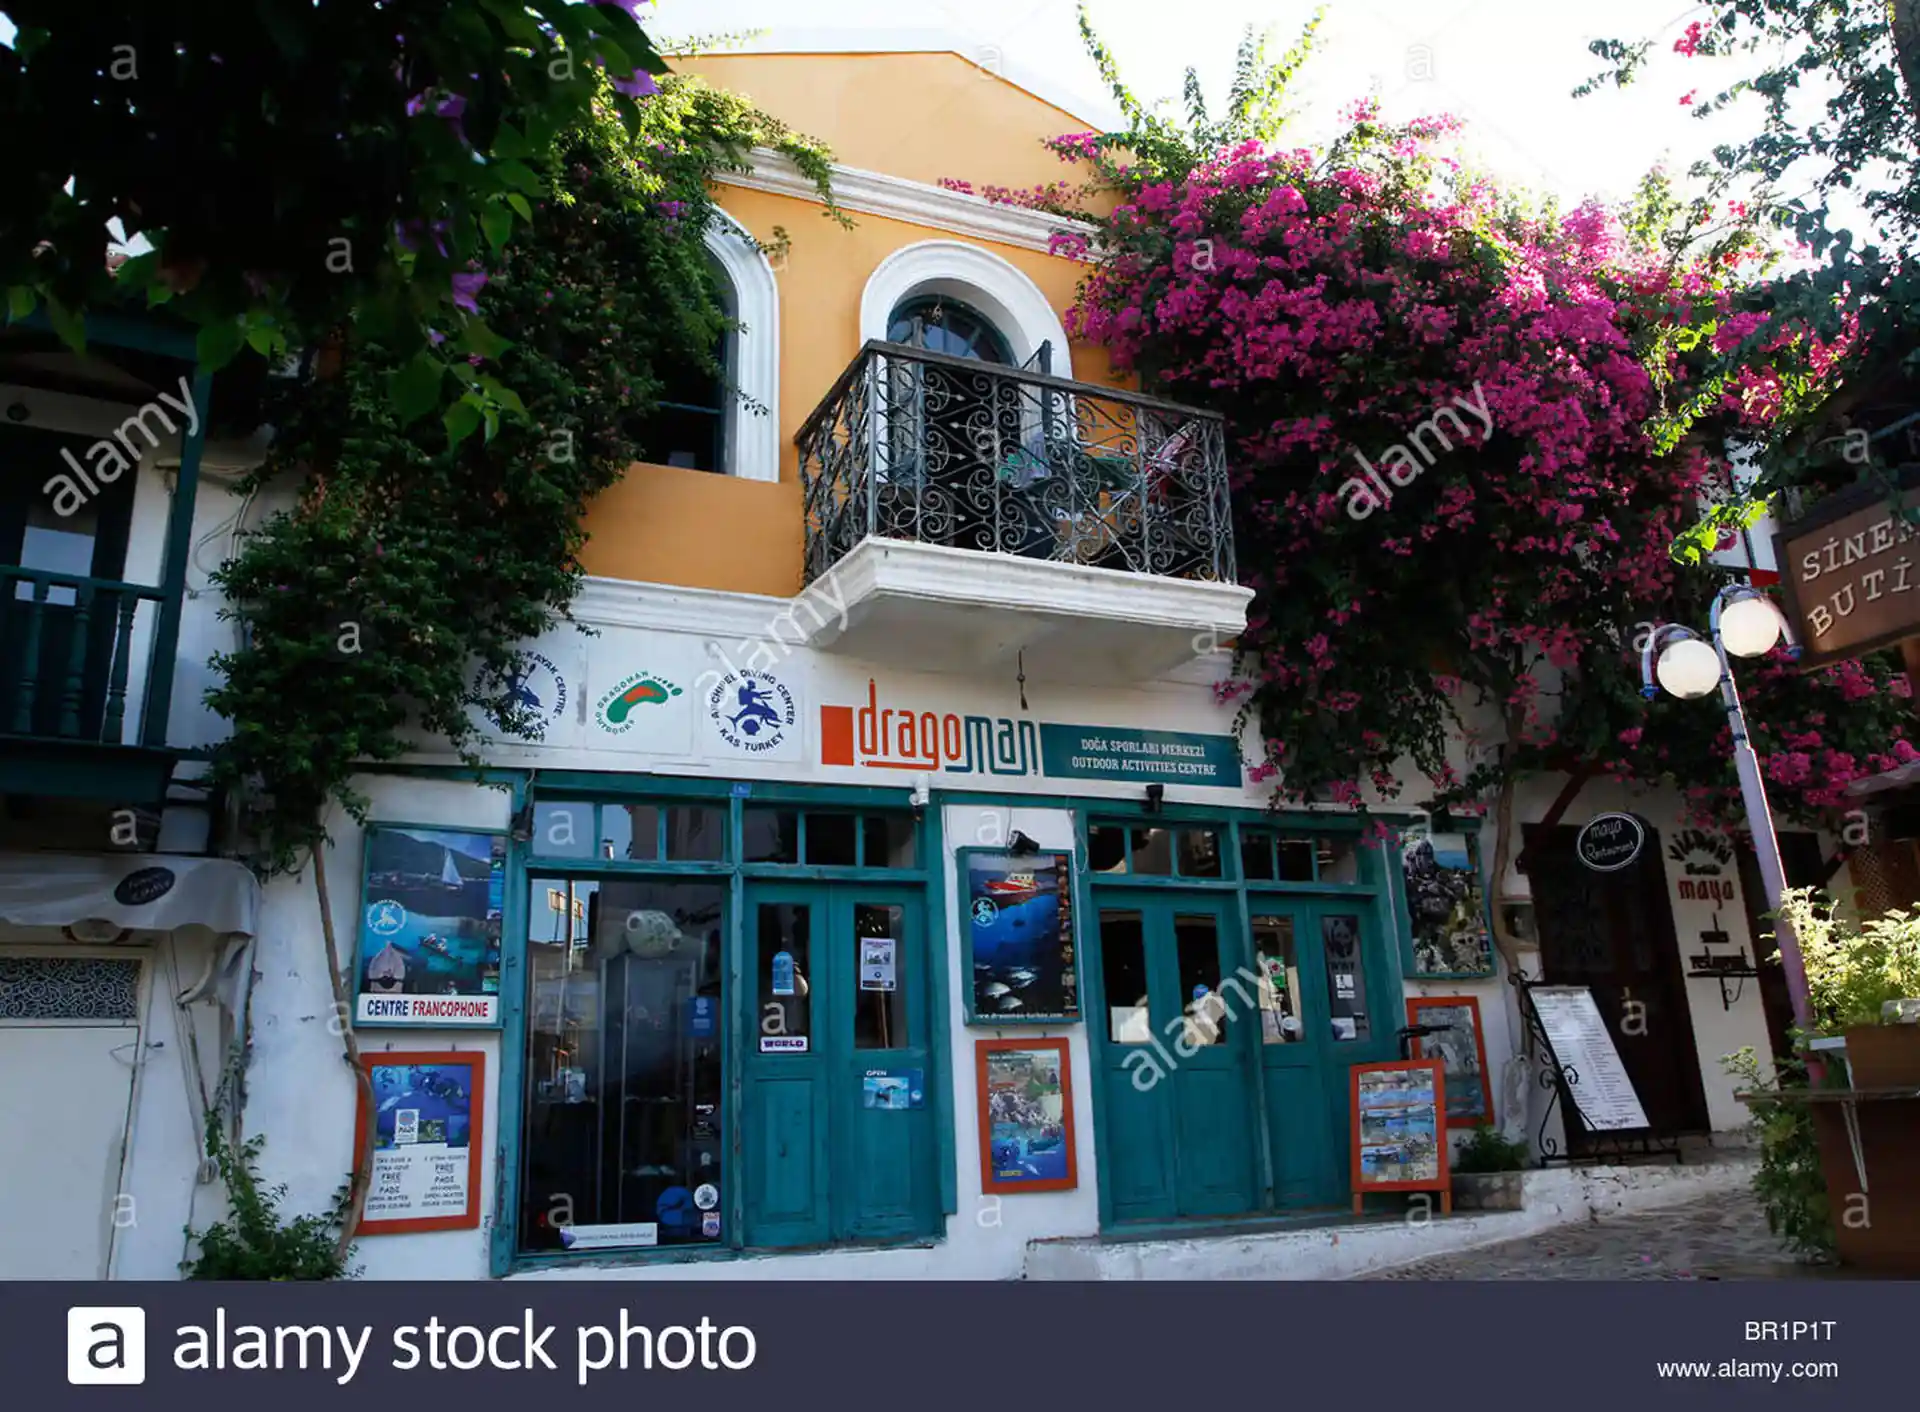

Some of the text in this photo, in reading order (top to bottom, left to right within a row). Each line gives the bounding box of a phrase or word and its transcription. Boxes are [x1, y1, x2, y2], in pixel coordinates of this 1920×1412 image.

[1803, 518, 1916, 582] SİNE
[1807, 556, 1920, 638] BUTİ
[776, 683, 795, 726] CENTER
[859, 678, 1040, 776] dragoman
[744, 732, 784, 752] TURKEY
[1072, 756, 1216, 776] OUTDOOR ACTIVITIES CENTRE
[1590, 820, 1622, 841] maya
[1678, 879, 1735, 910] maya
[367, 999, 489, 1017] CENTRE FRANCOPHONE
[763, 1039, 804, 1048] WORLD
